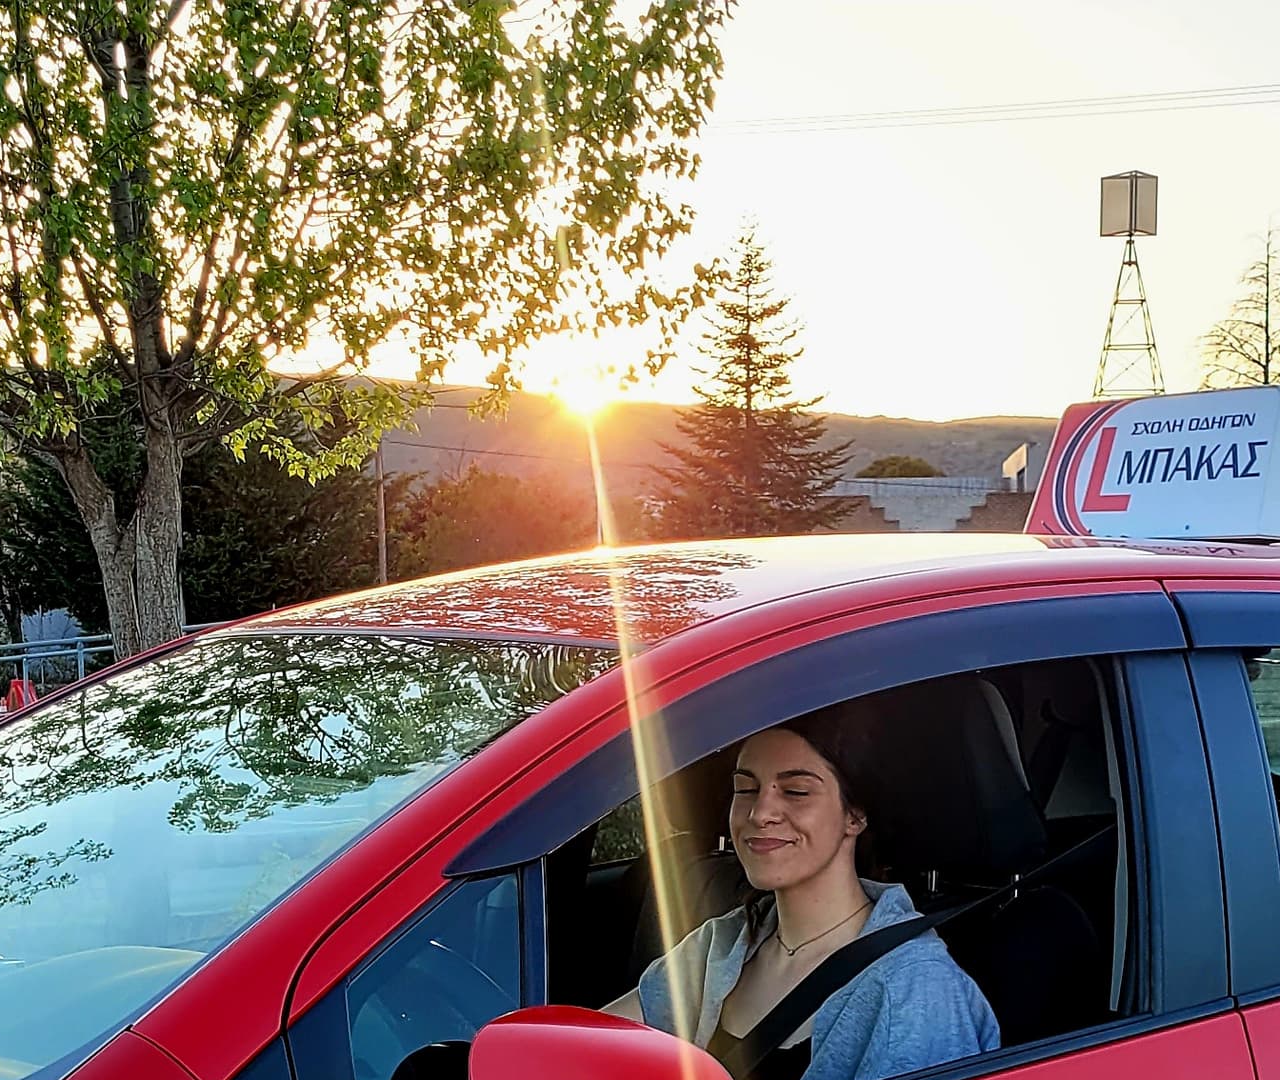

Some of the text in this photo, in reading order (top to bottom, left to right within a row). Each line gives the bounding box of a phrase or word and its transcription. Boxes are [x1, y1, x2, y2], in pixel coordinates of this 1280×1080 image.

[1130, 412, 1256, 436] ΣΧΟΛΗ ΟΔΗΓΩΝ
[1081, 426, 1131, 513] L
[1116, 440, 1269, 486] ΜΠΑΚΑΣ
